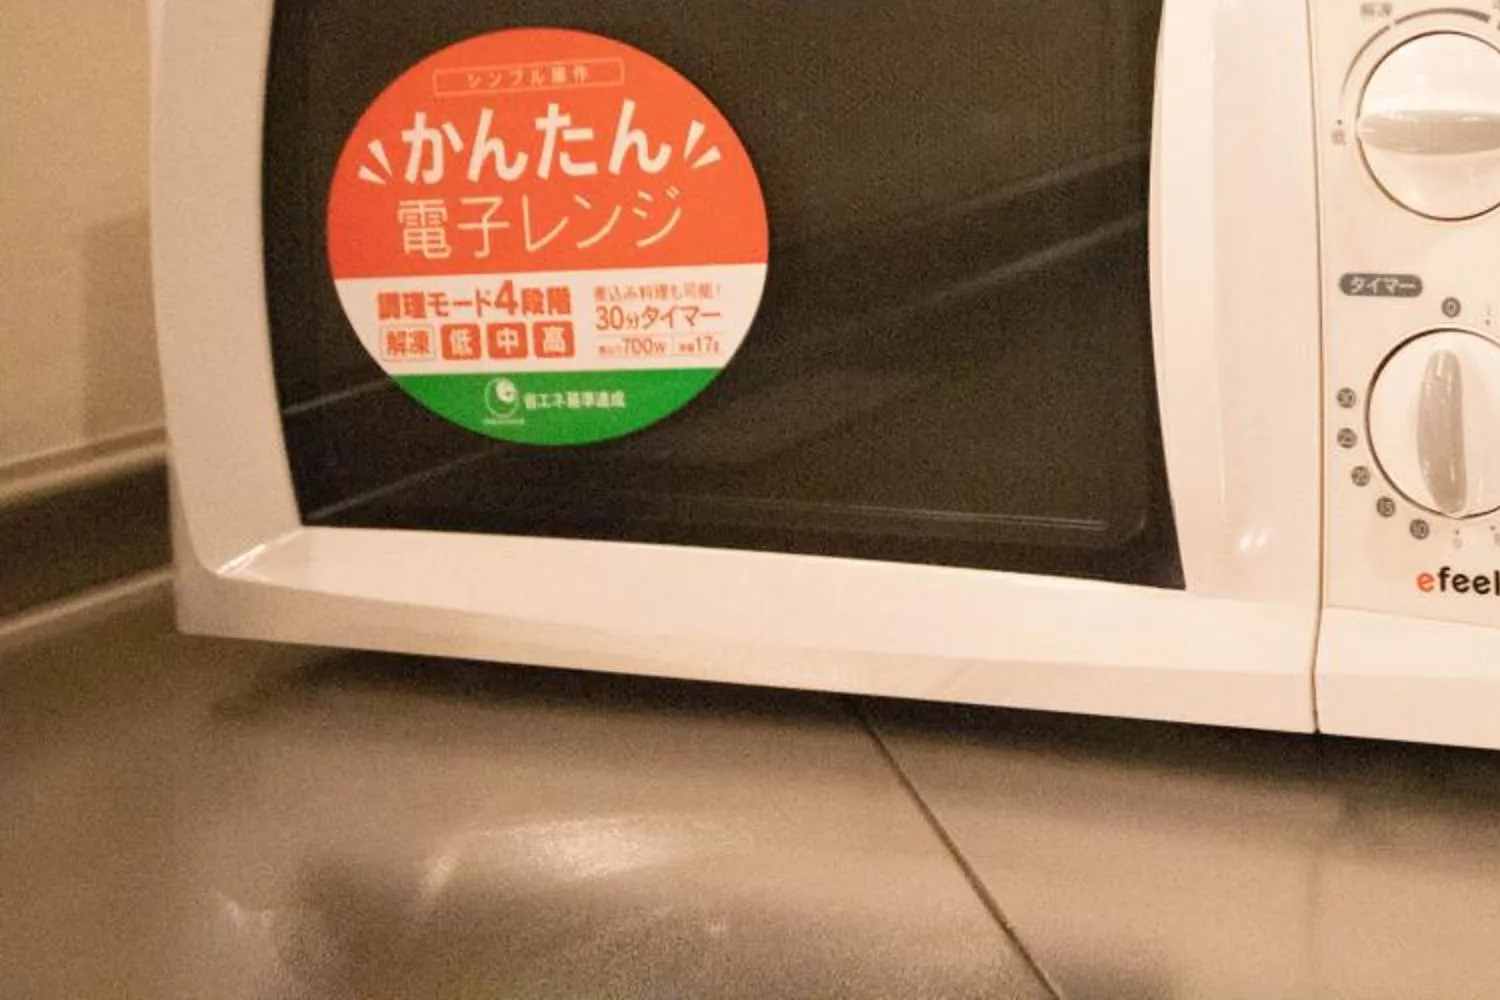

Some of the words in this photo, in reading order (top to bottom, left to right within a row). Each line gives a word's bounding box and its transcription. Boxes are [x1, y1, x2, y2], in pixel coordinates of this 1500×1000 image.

[402, 99, 672, 185] かんたん
[397, 186, 682, 260] 電子レンジ
[1349, 276, 1416, 294] タイマー
[595, 304, 721, 330] 30分タイマー
[496, 326, 519, 355] 中
[542, 325, 567, 354] 高
